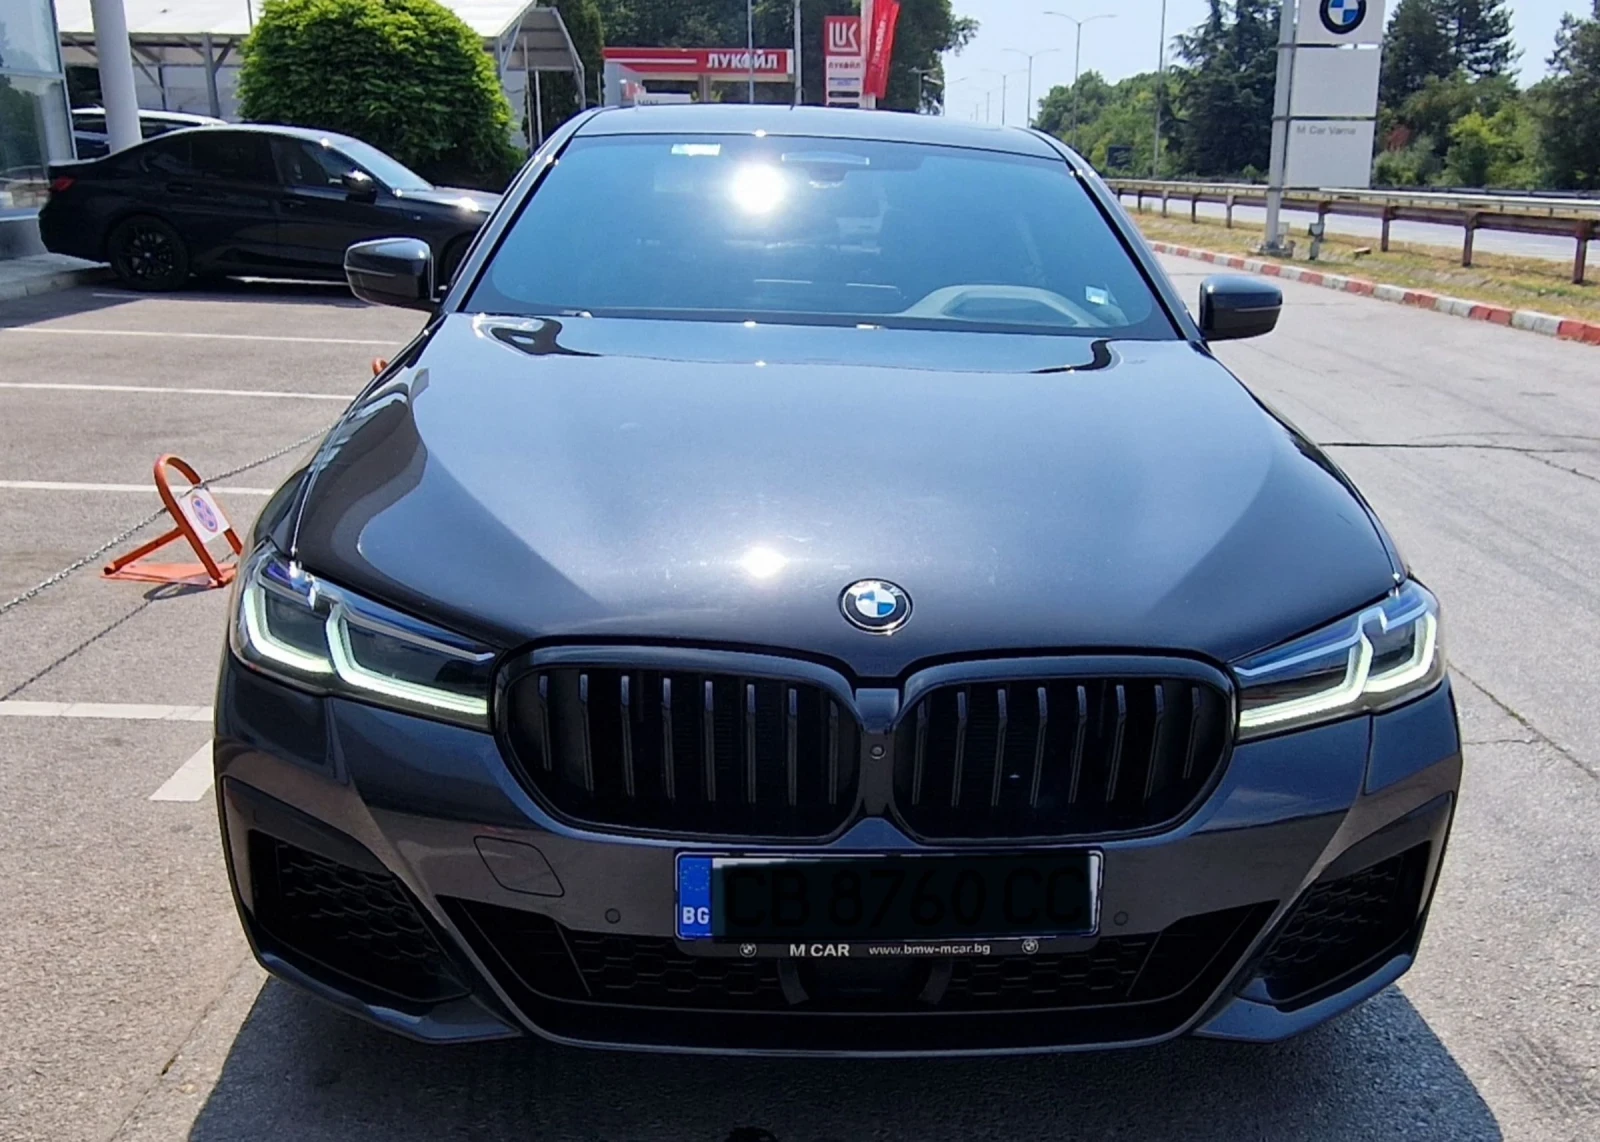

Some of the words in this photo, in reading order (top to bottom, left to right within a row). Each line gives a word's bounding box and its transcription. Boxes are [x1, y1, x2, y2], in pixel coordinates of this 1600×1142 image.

[706, 50, 778, 69] ЛУКОЙЛ
[1296, 125, 1306, 135] M
[1309, 125, 1326, 135] Car
[682, 906, 710, 925] BG
[789, 943, 806, 957] M
[810, 943, 850, 957] CAR
[868, 943, 991, 955] www.bmw-mcar.bg
